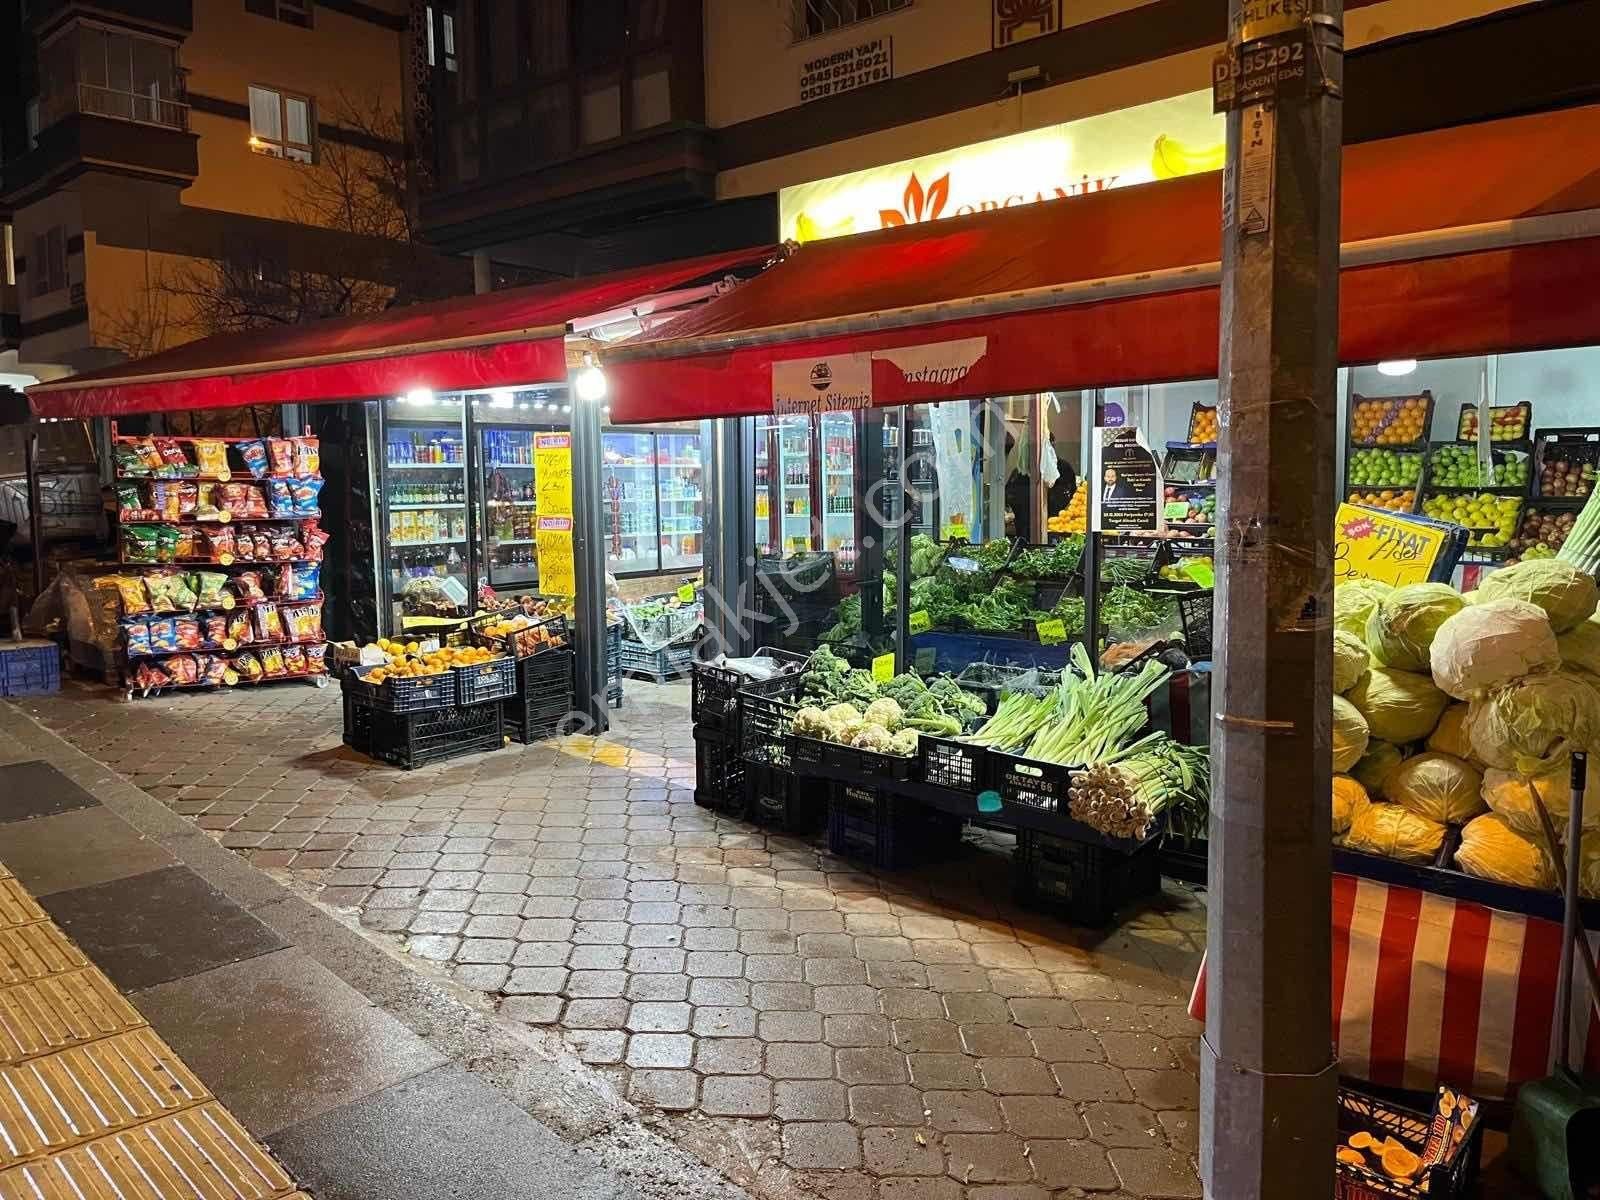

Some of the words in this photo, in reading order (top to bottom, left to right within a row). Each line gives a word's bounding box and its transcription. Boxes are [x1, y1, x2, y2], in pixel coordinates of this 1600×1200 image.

[804, 48, 854, 74] MODERN
[856, 40, 882, 58] YAPI
[826, 391, 871, 412] Sitemiz
